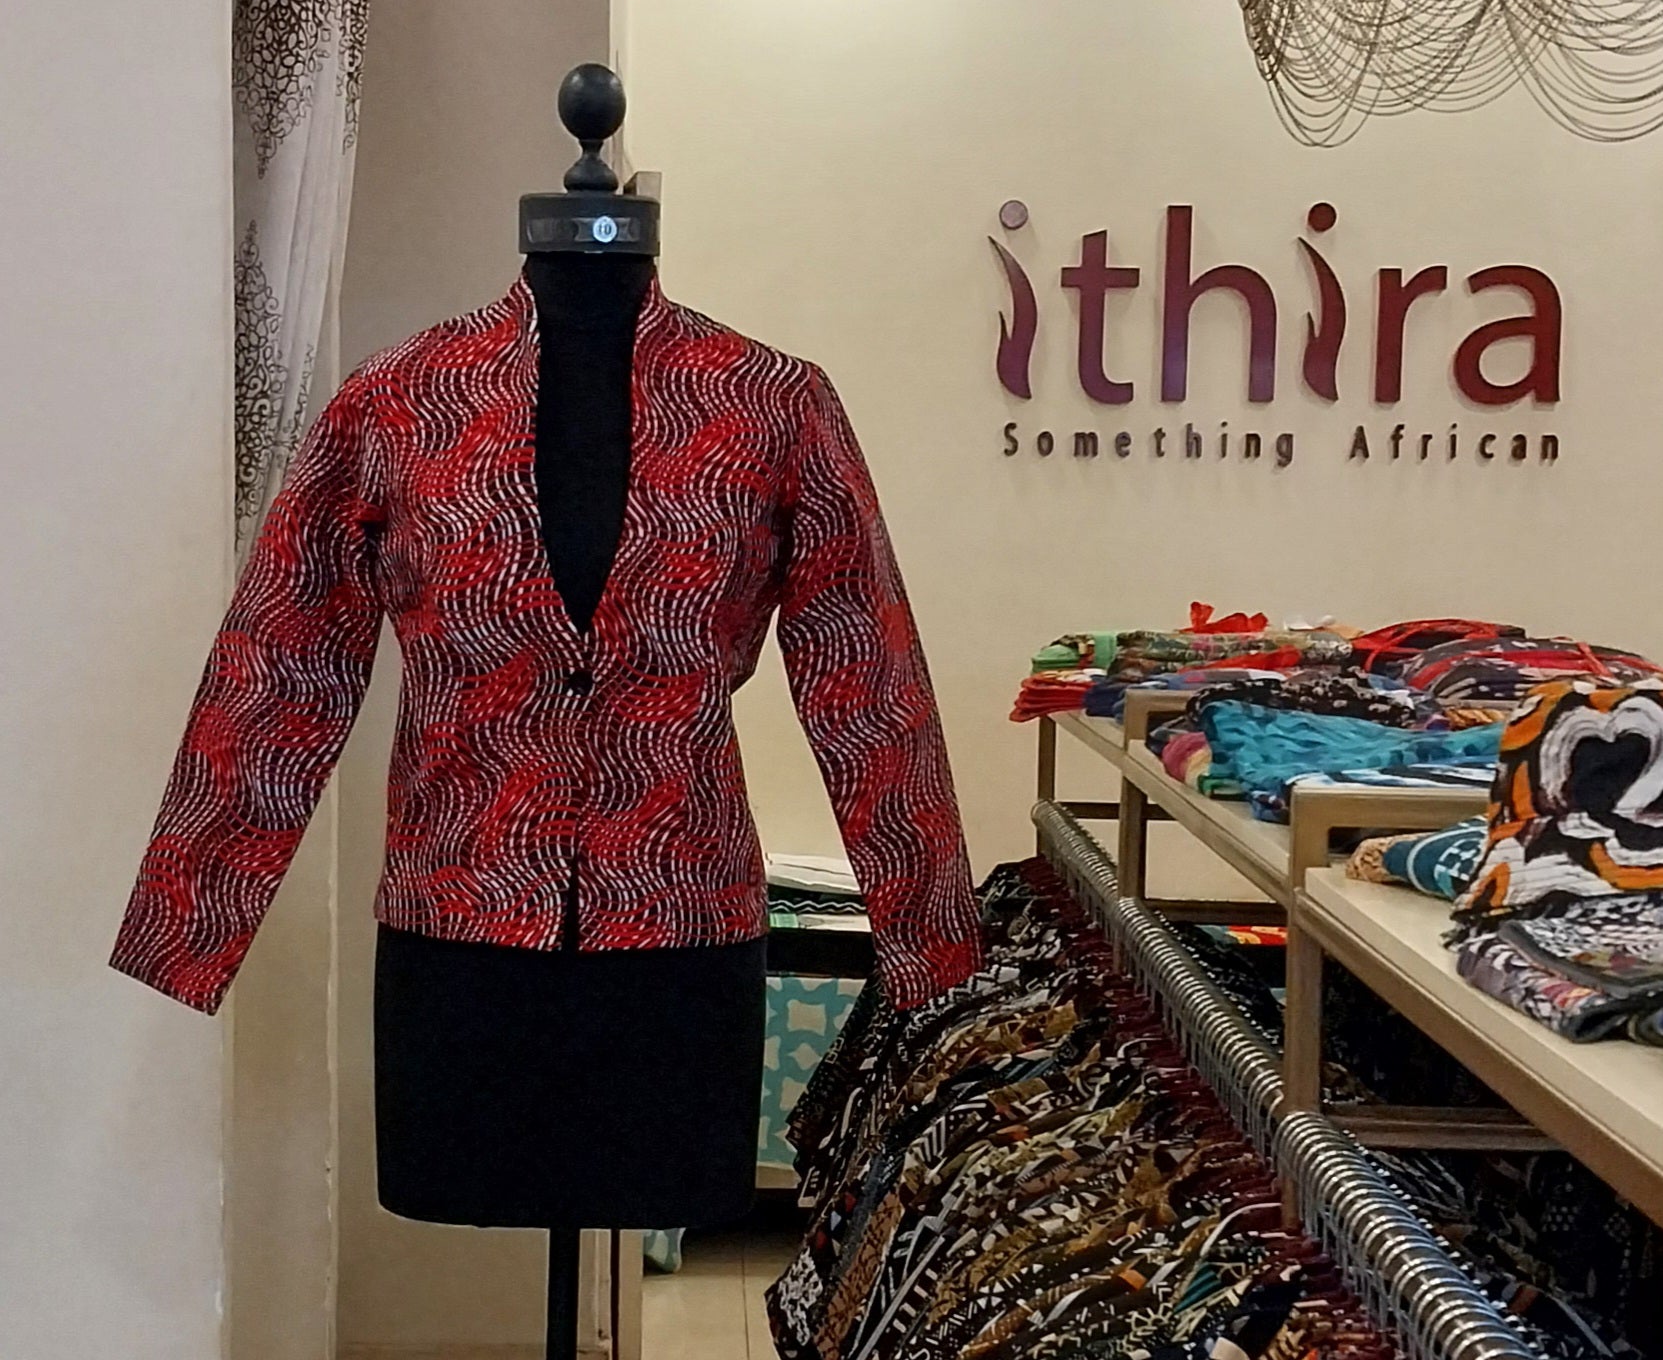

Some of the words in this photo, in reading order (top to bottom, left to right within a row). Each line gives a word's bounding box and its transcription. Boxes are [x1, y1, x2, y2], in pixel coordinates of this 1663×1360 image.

[987, 200, 1563, 404] ithira
[1002, 421, 1295, 468] Something
[1348, 422, 1562, 461] African
